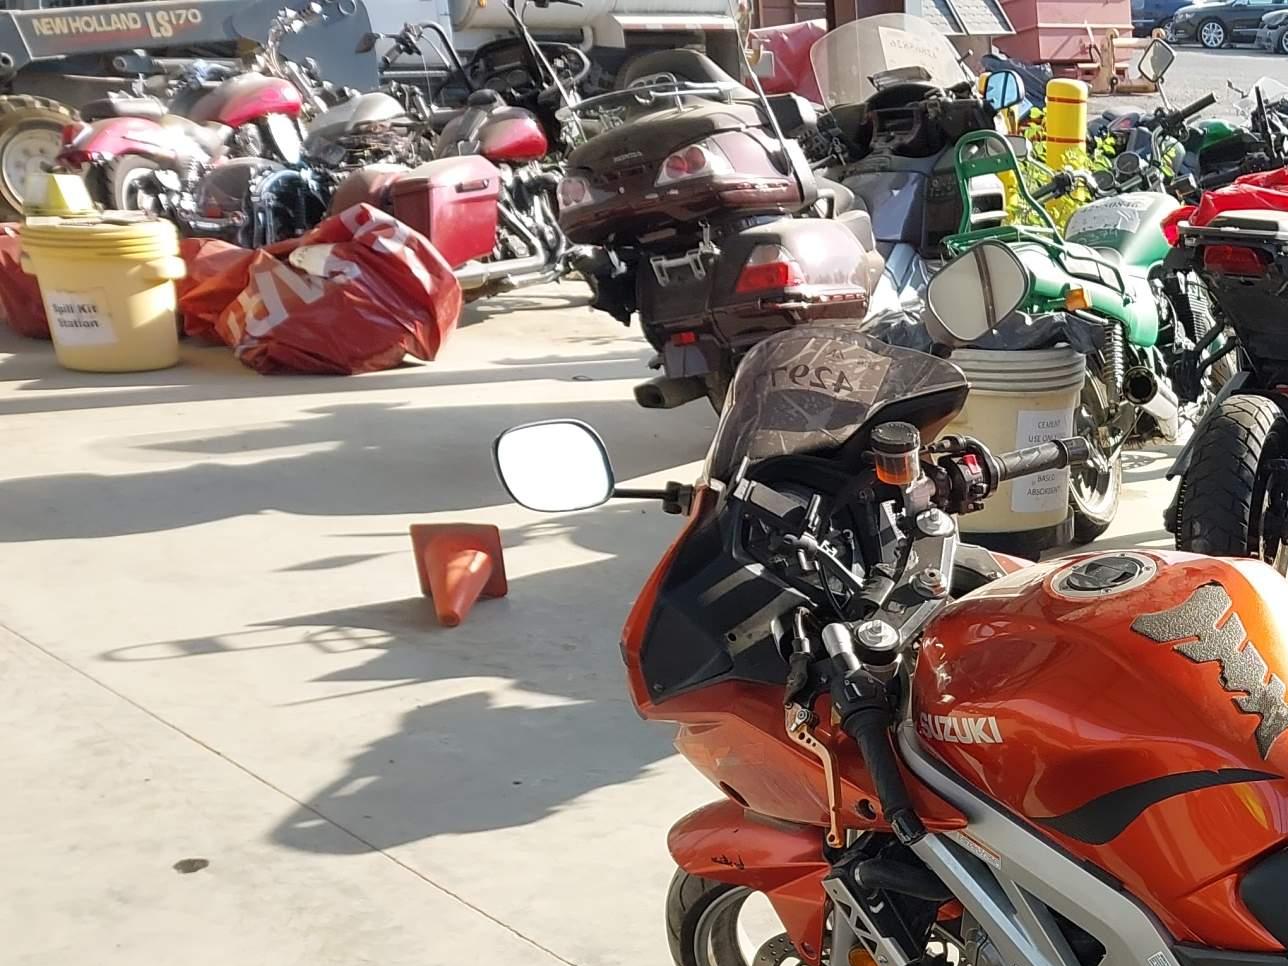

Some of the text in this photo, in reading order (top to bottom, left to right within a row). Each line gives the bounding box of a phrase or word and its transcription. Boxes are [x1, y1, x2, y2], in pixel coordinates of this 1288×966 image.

[32, 18, 69, 36] NEW
[69, 13, 142, 33] HOLLAND
[917, 712, 1004, 745] SUZUKI
